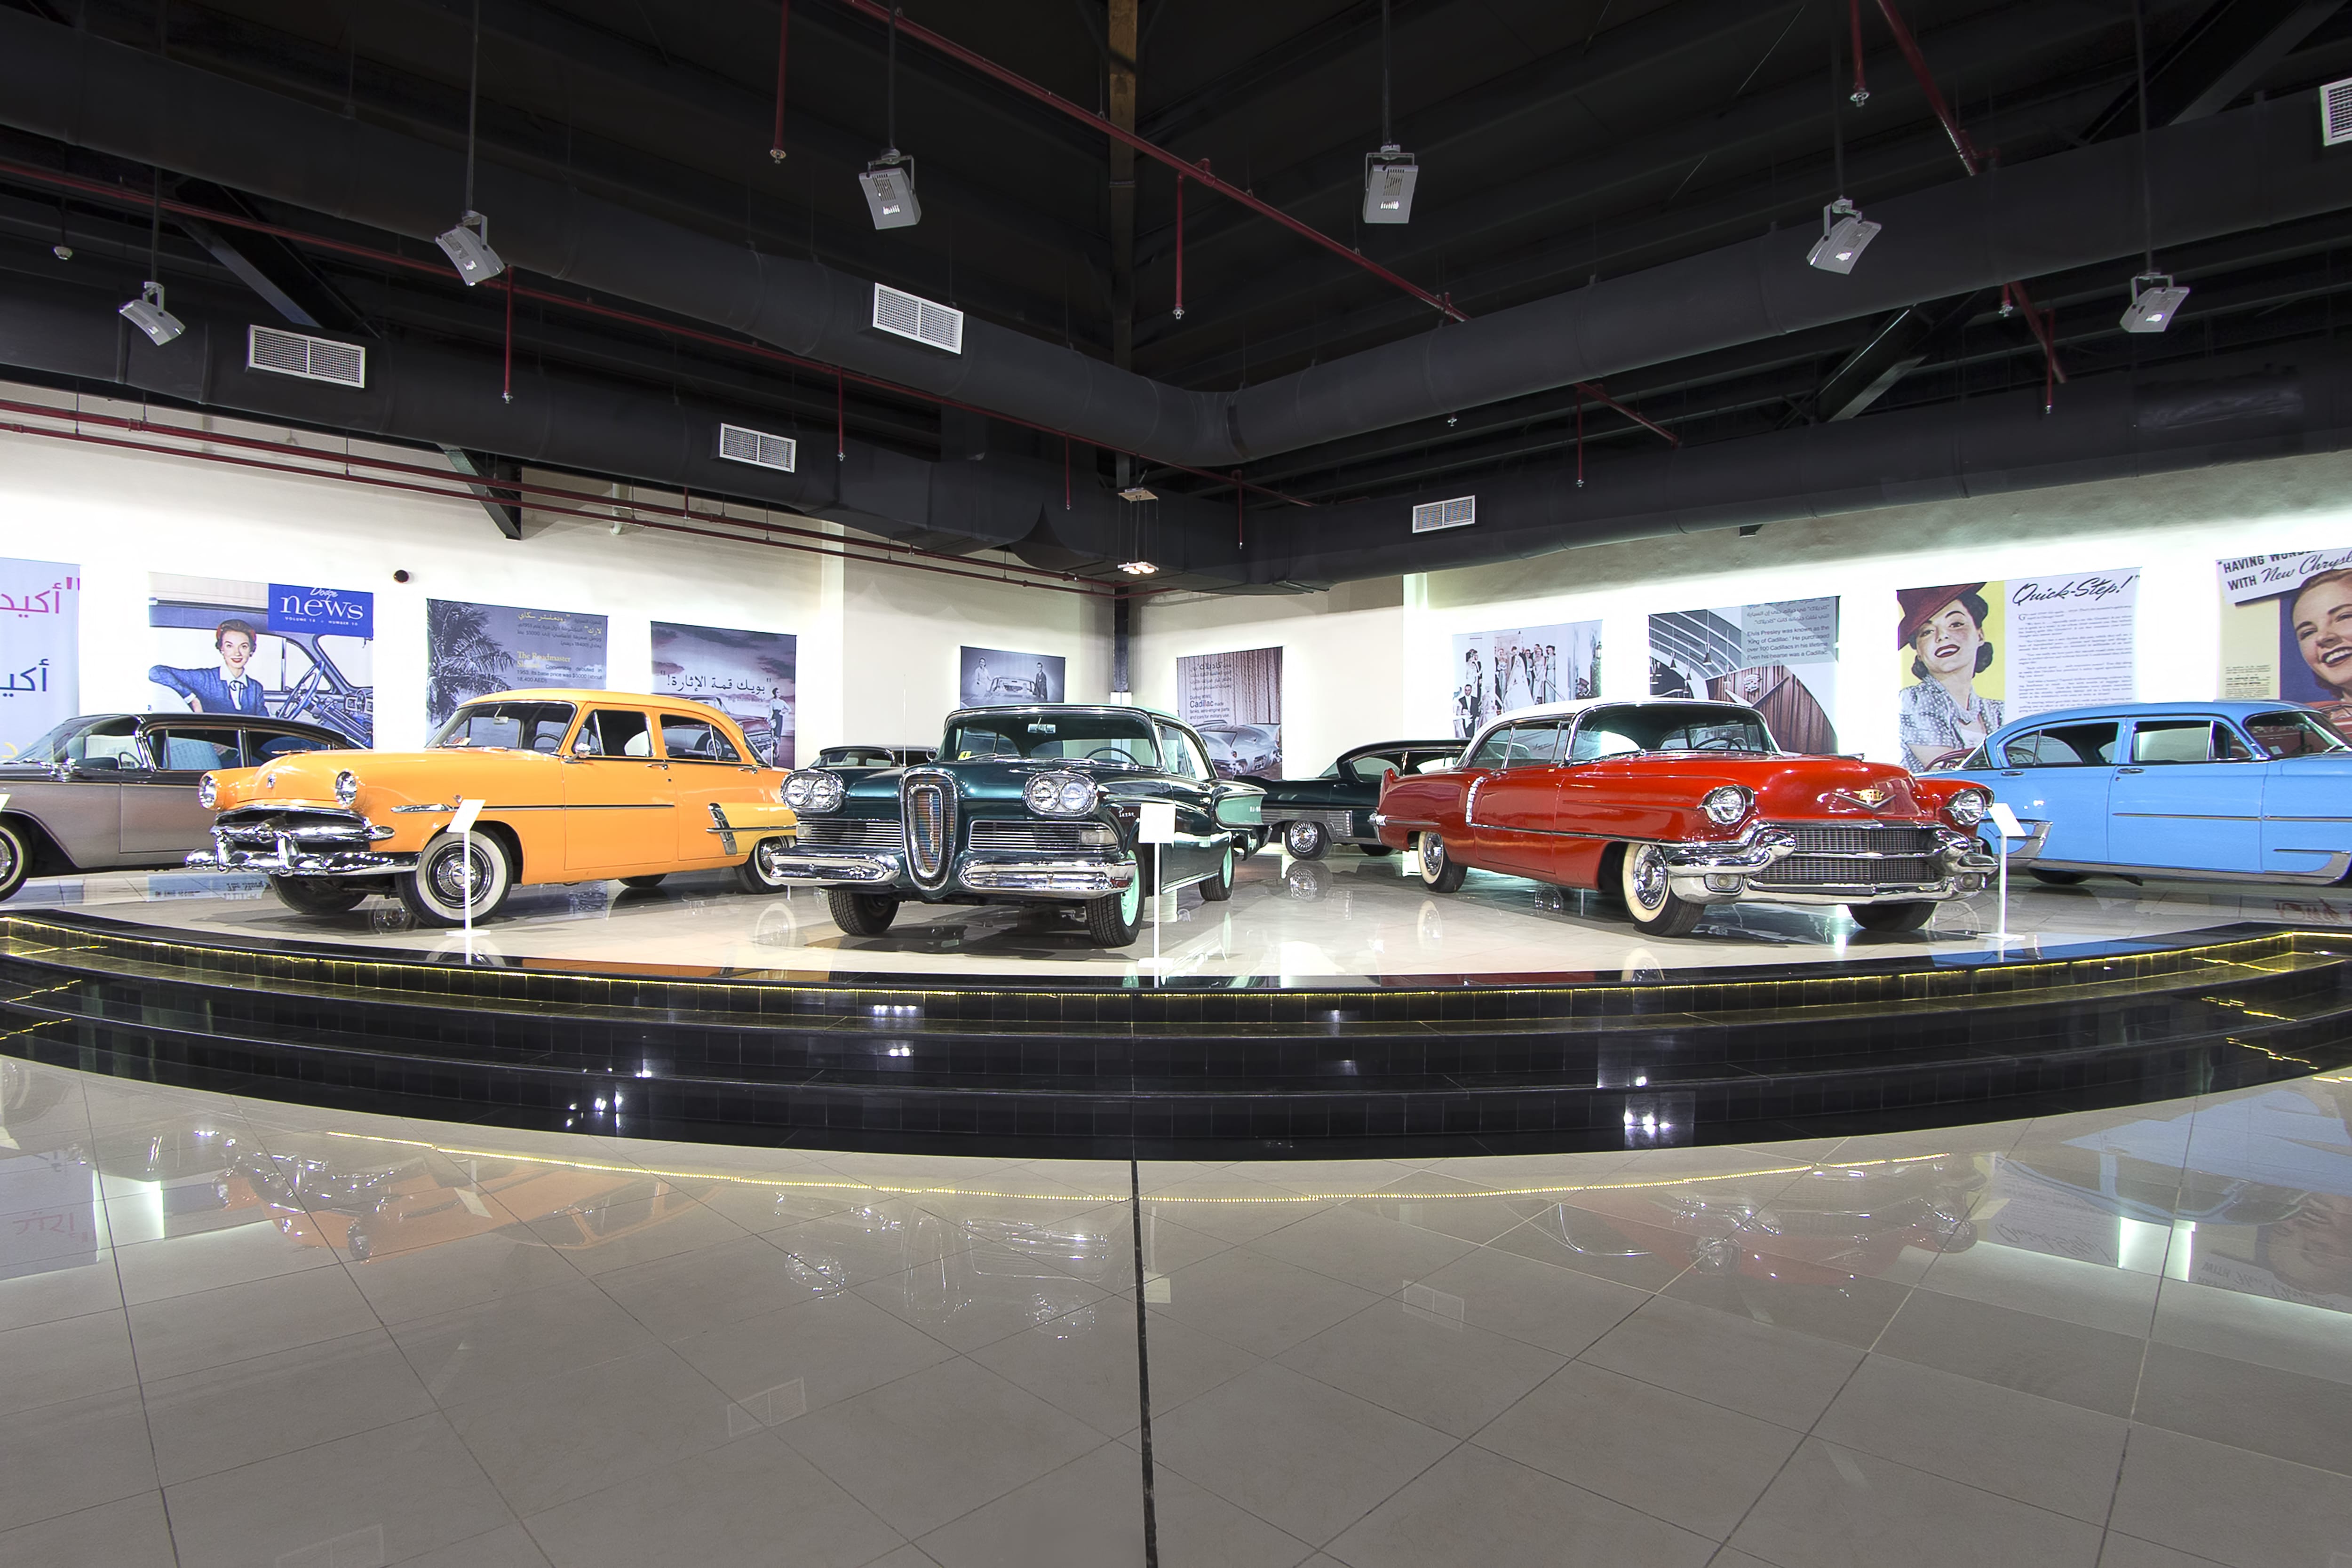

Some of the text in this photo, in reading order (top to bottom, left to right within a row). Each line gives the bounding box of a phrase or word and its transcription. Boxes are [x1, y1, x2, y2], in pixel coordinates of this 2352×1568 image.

[2227, 575, 2257, 590] WITH
[2261, 566, 2296, 583] New
[310, 588, 339, 600] Dodge
[280, 595, 364, 620] news
[517, 651, 571, 663] The Roadmaster
[0, 658, 49, 697] أكي
[711, 677, 733, 691] قمة
[1189, 700, 1214, 708] Cadillac
